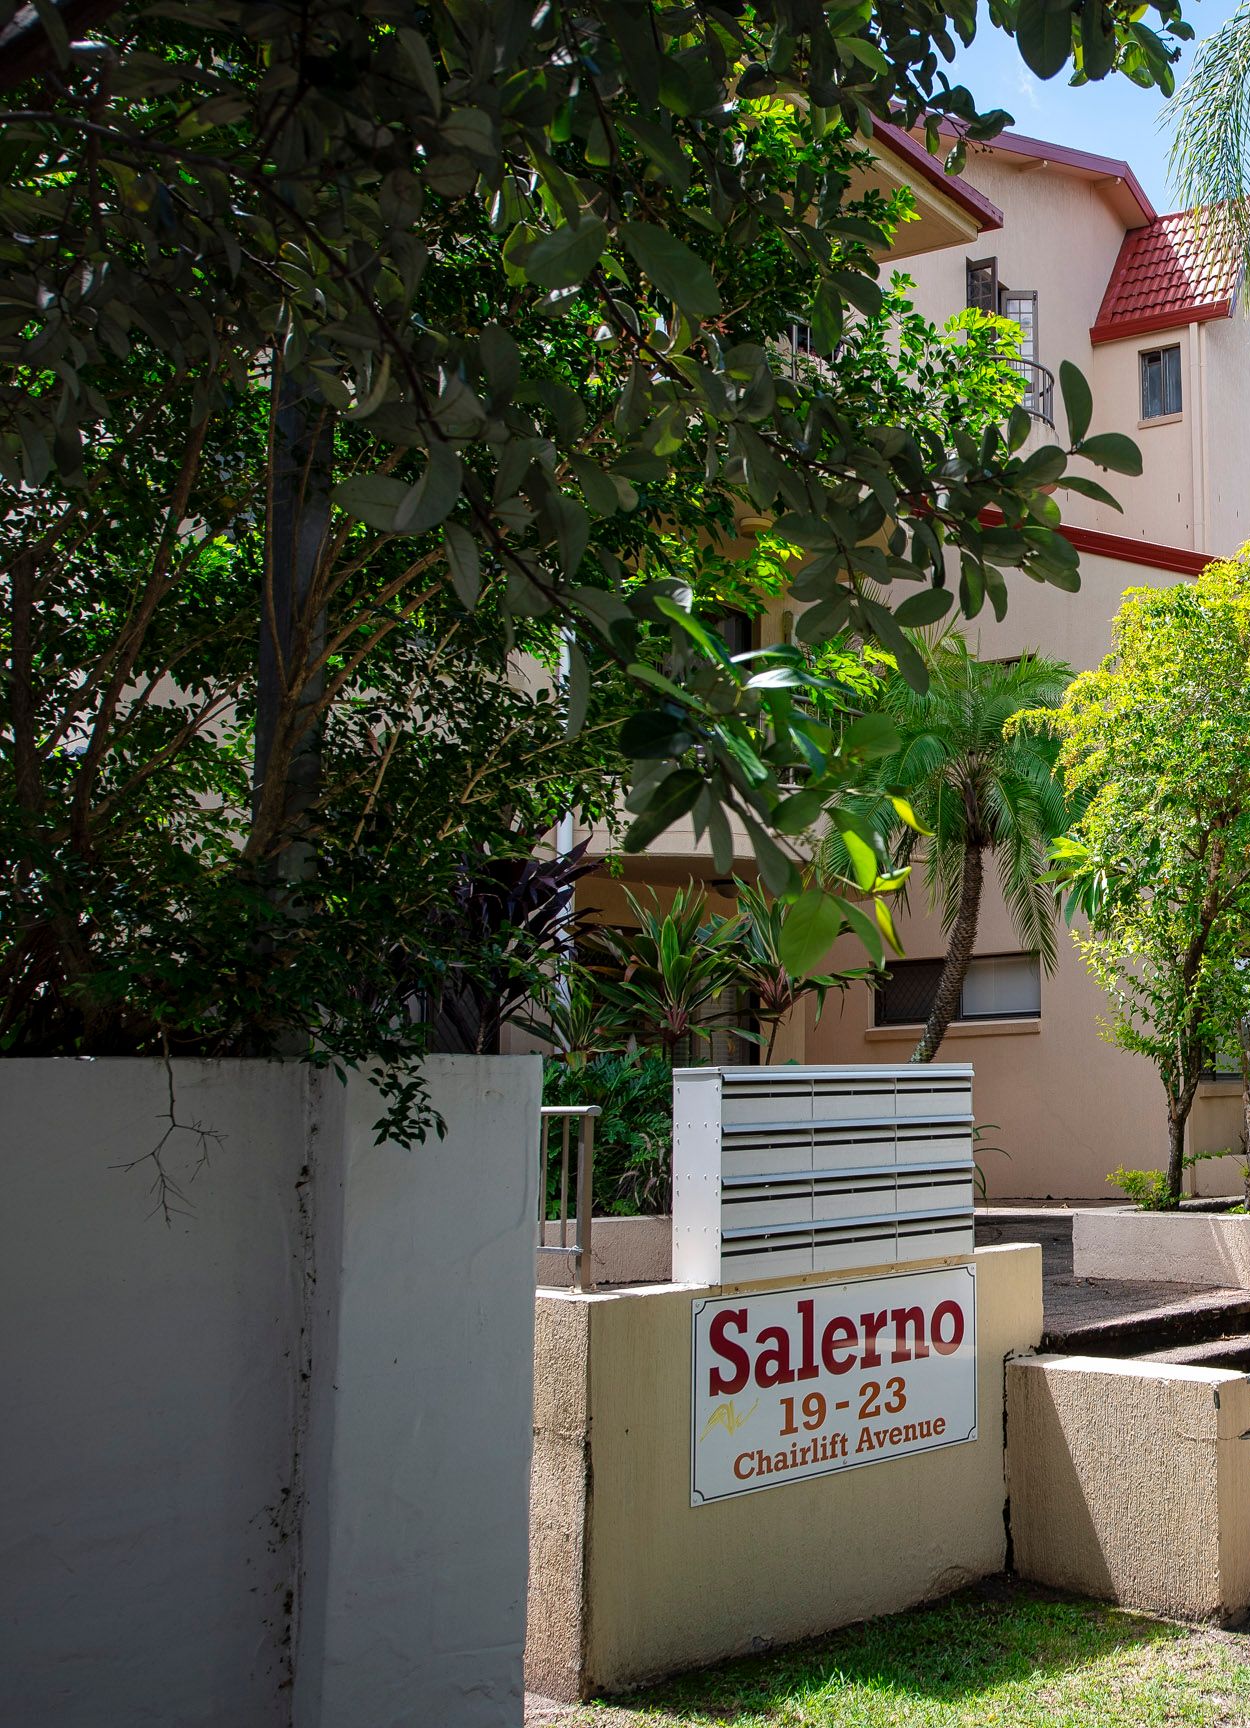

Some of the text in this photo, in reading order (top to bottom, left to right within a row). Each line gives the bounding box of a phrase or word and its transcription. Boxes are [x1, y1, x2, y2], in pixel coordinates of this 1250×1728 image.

[709, 1299, 965, 1397] Salerno
[733, 1417, 946, 1480] Chairlift Avenue
